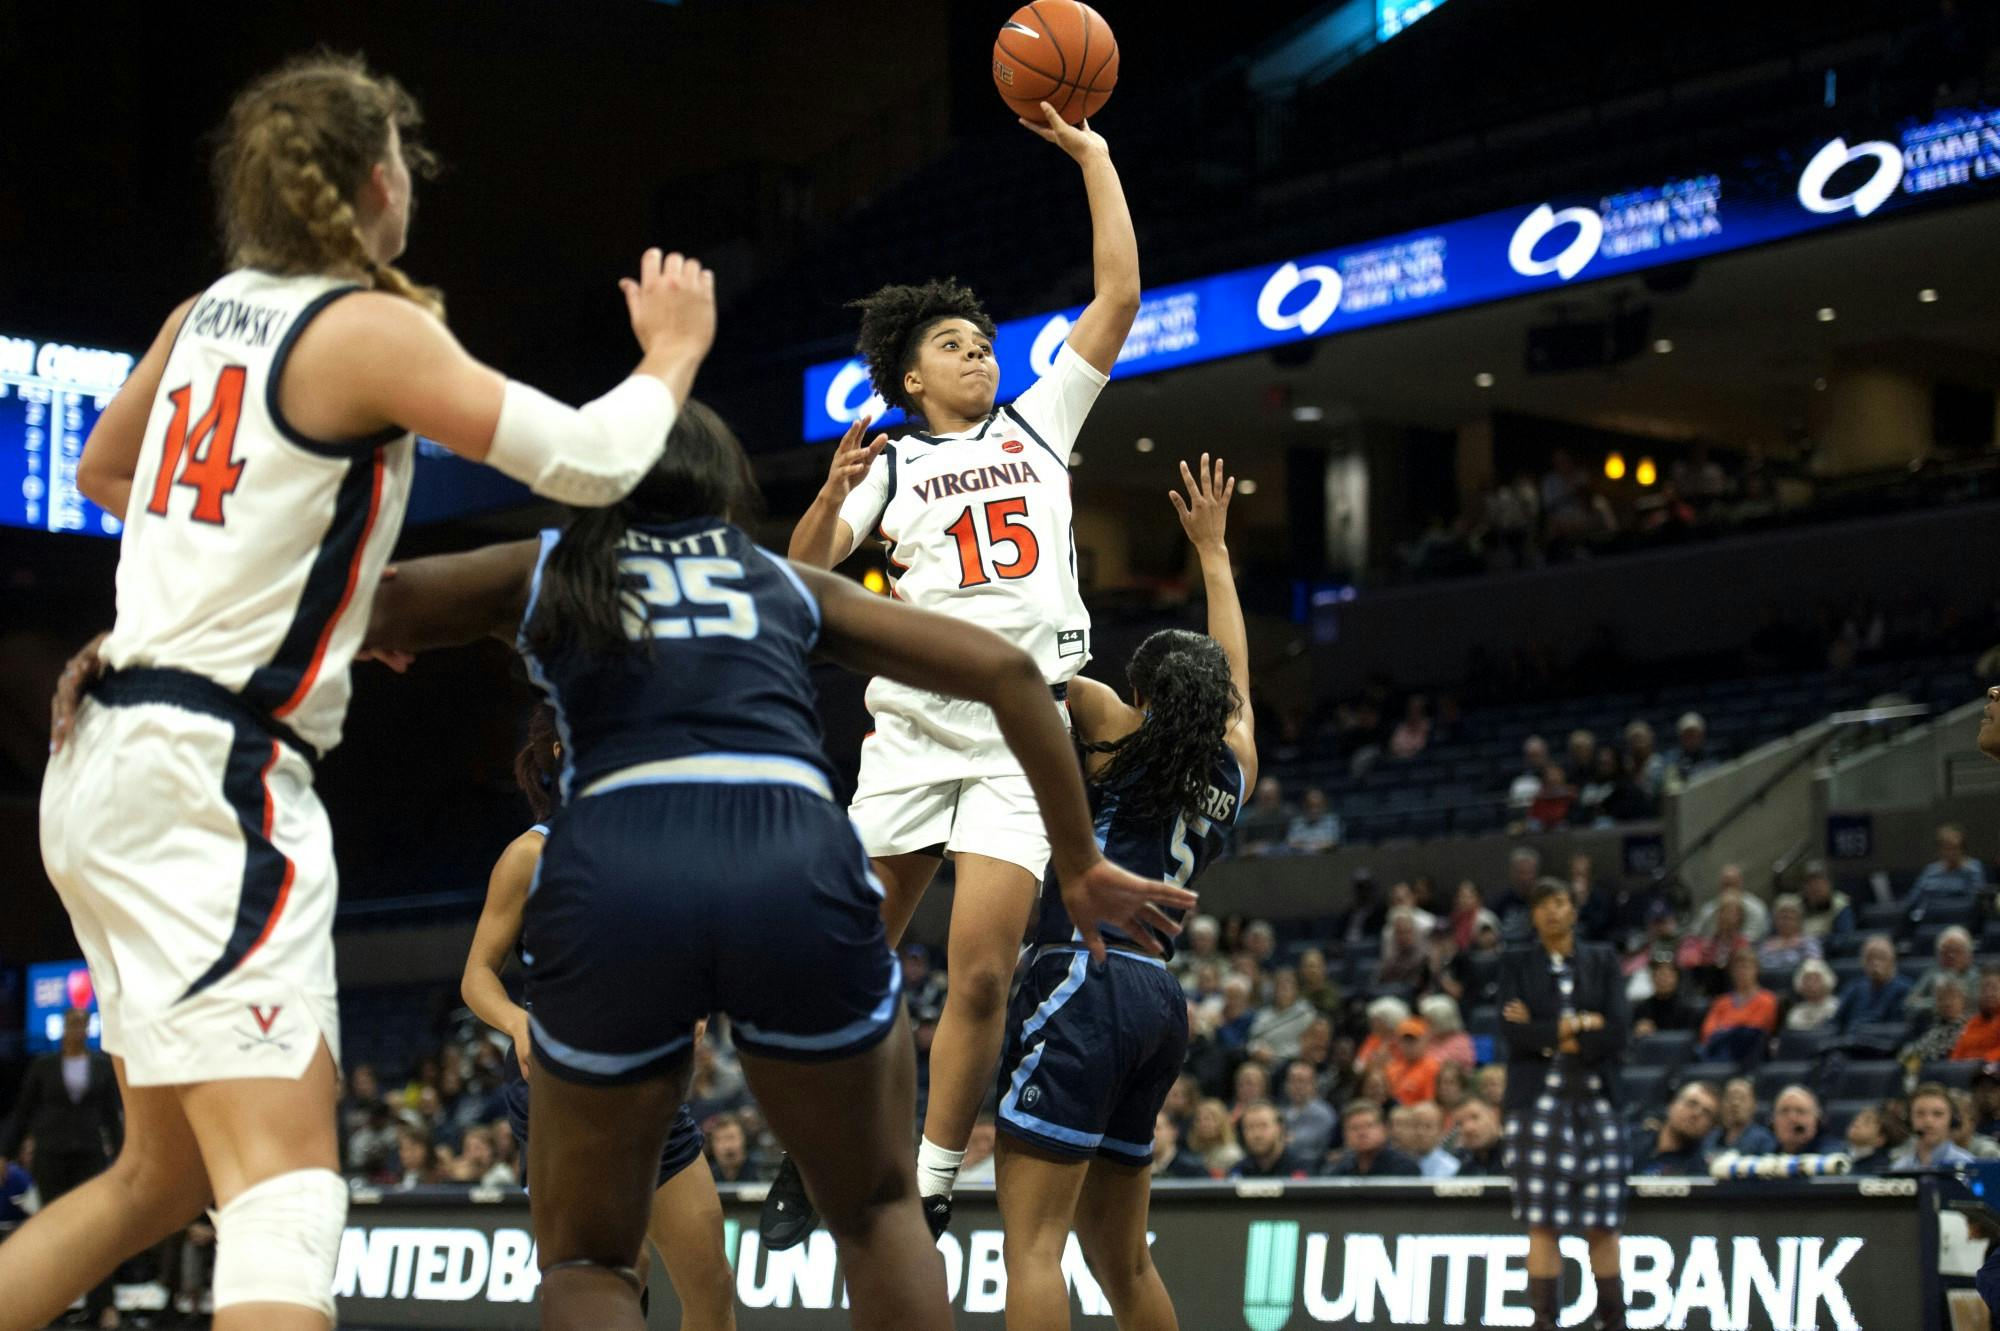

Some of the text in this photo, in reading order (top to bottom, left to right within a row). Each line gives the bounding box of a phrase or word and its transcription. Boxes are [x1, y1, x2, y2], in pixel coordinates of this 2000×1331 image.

[146, 364, 248, 527] 14
[912, 461, 1041, 504] VIRGINIA
[944, 496, 1039, 589] 15
[617, 557, 759, 641] 25
[1062, 631, 1079, 641] 44
[1163, 808, 1212, 889] 5
[331, 1226, 491, 1301] NITED
[1303, 1233, 1866, 1331] UNITED BANK
